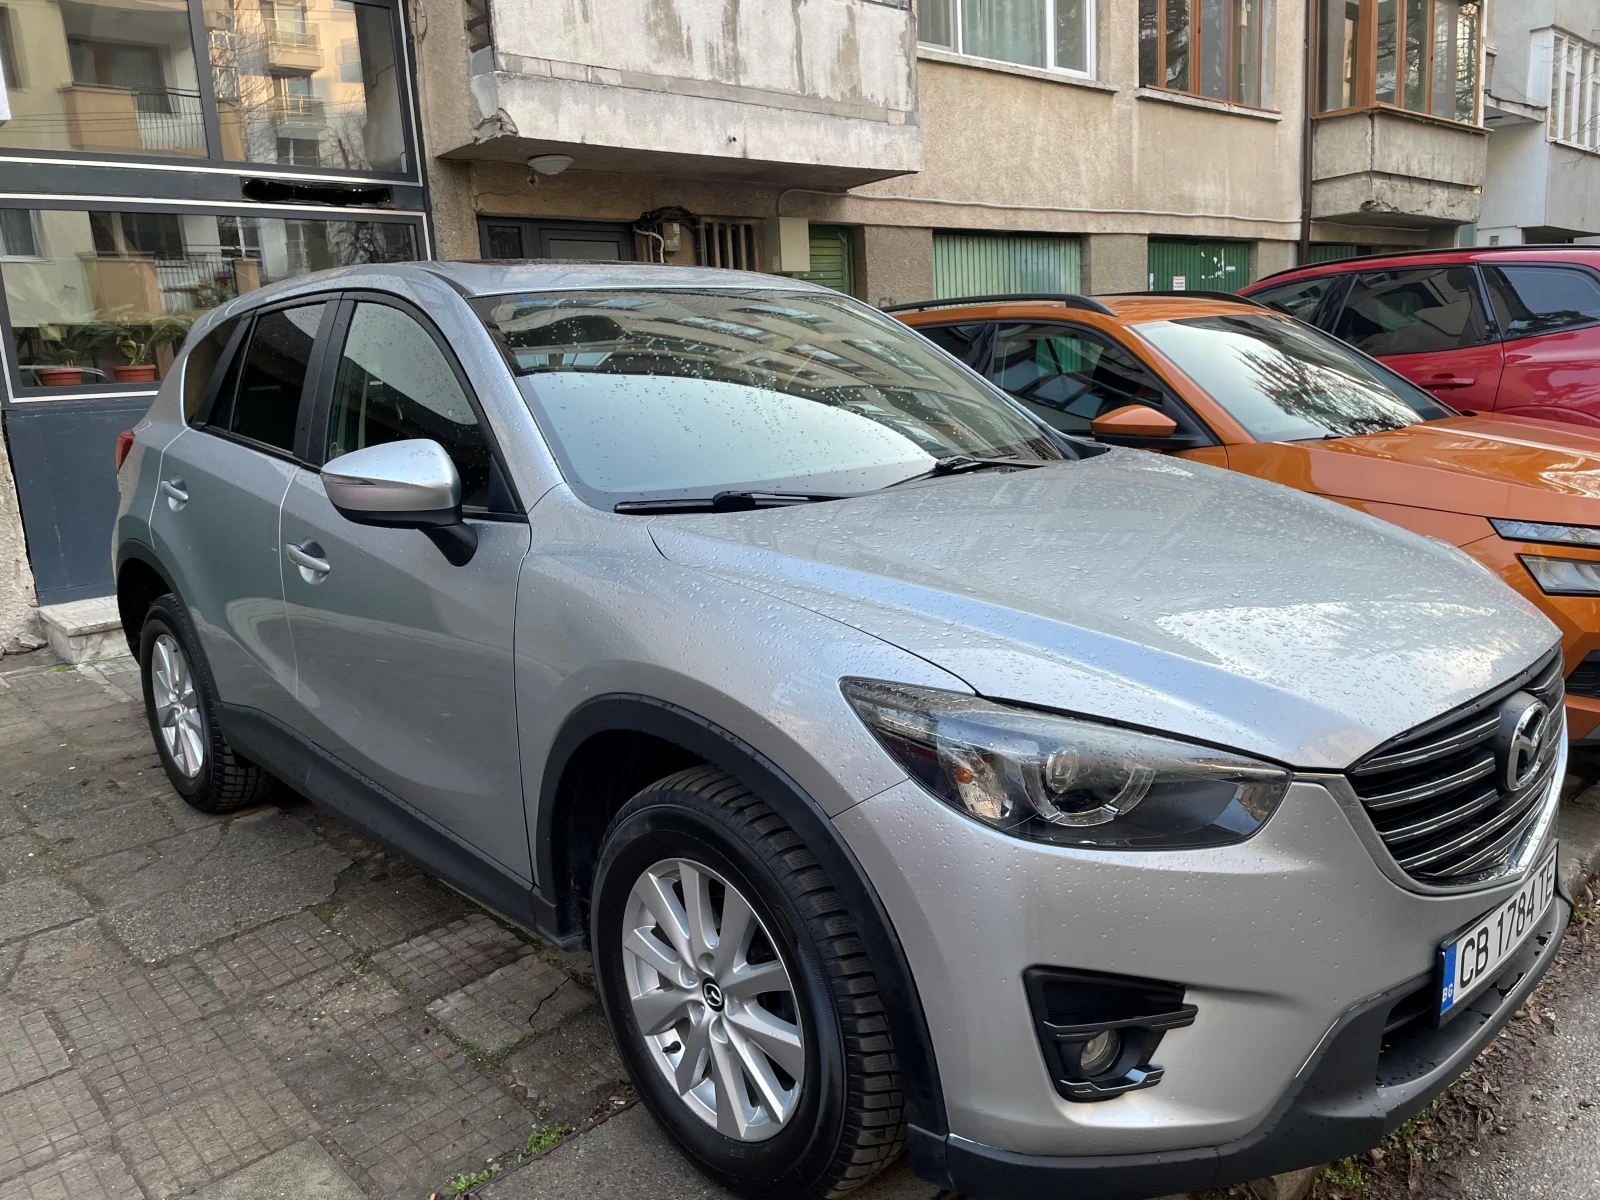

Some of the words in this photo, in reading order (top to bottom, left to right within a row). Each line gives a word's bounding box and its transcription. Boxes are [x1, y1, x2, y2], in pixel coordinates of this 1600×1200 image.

[1460, 927, 1489, 989] CB
[1497, 879, 1535, 958] 1784
[1539, 853, 1555, 911] TE
[1442, 983, 1454, 1002] BG
